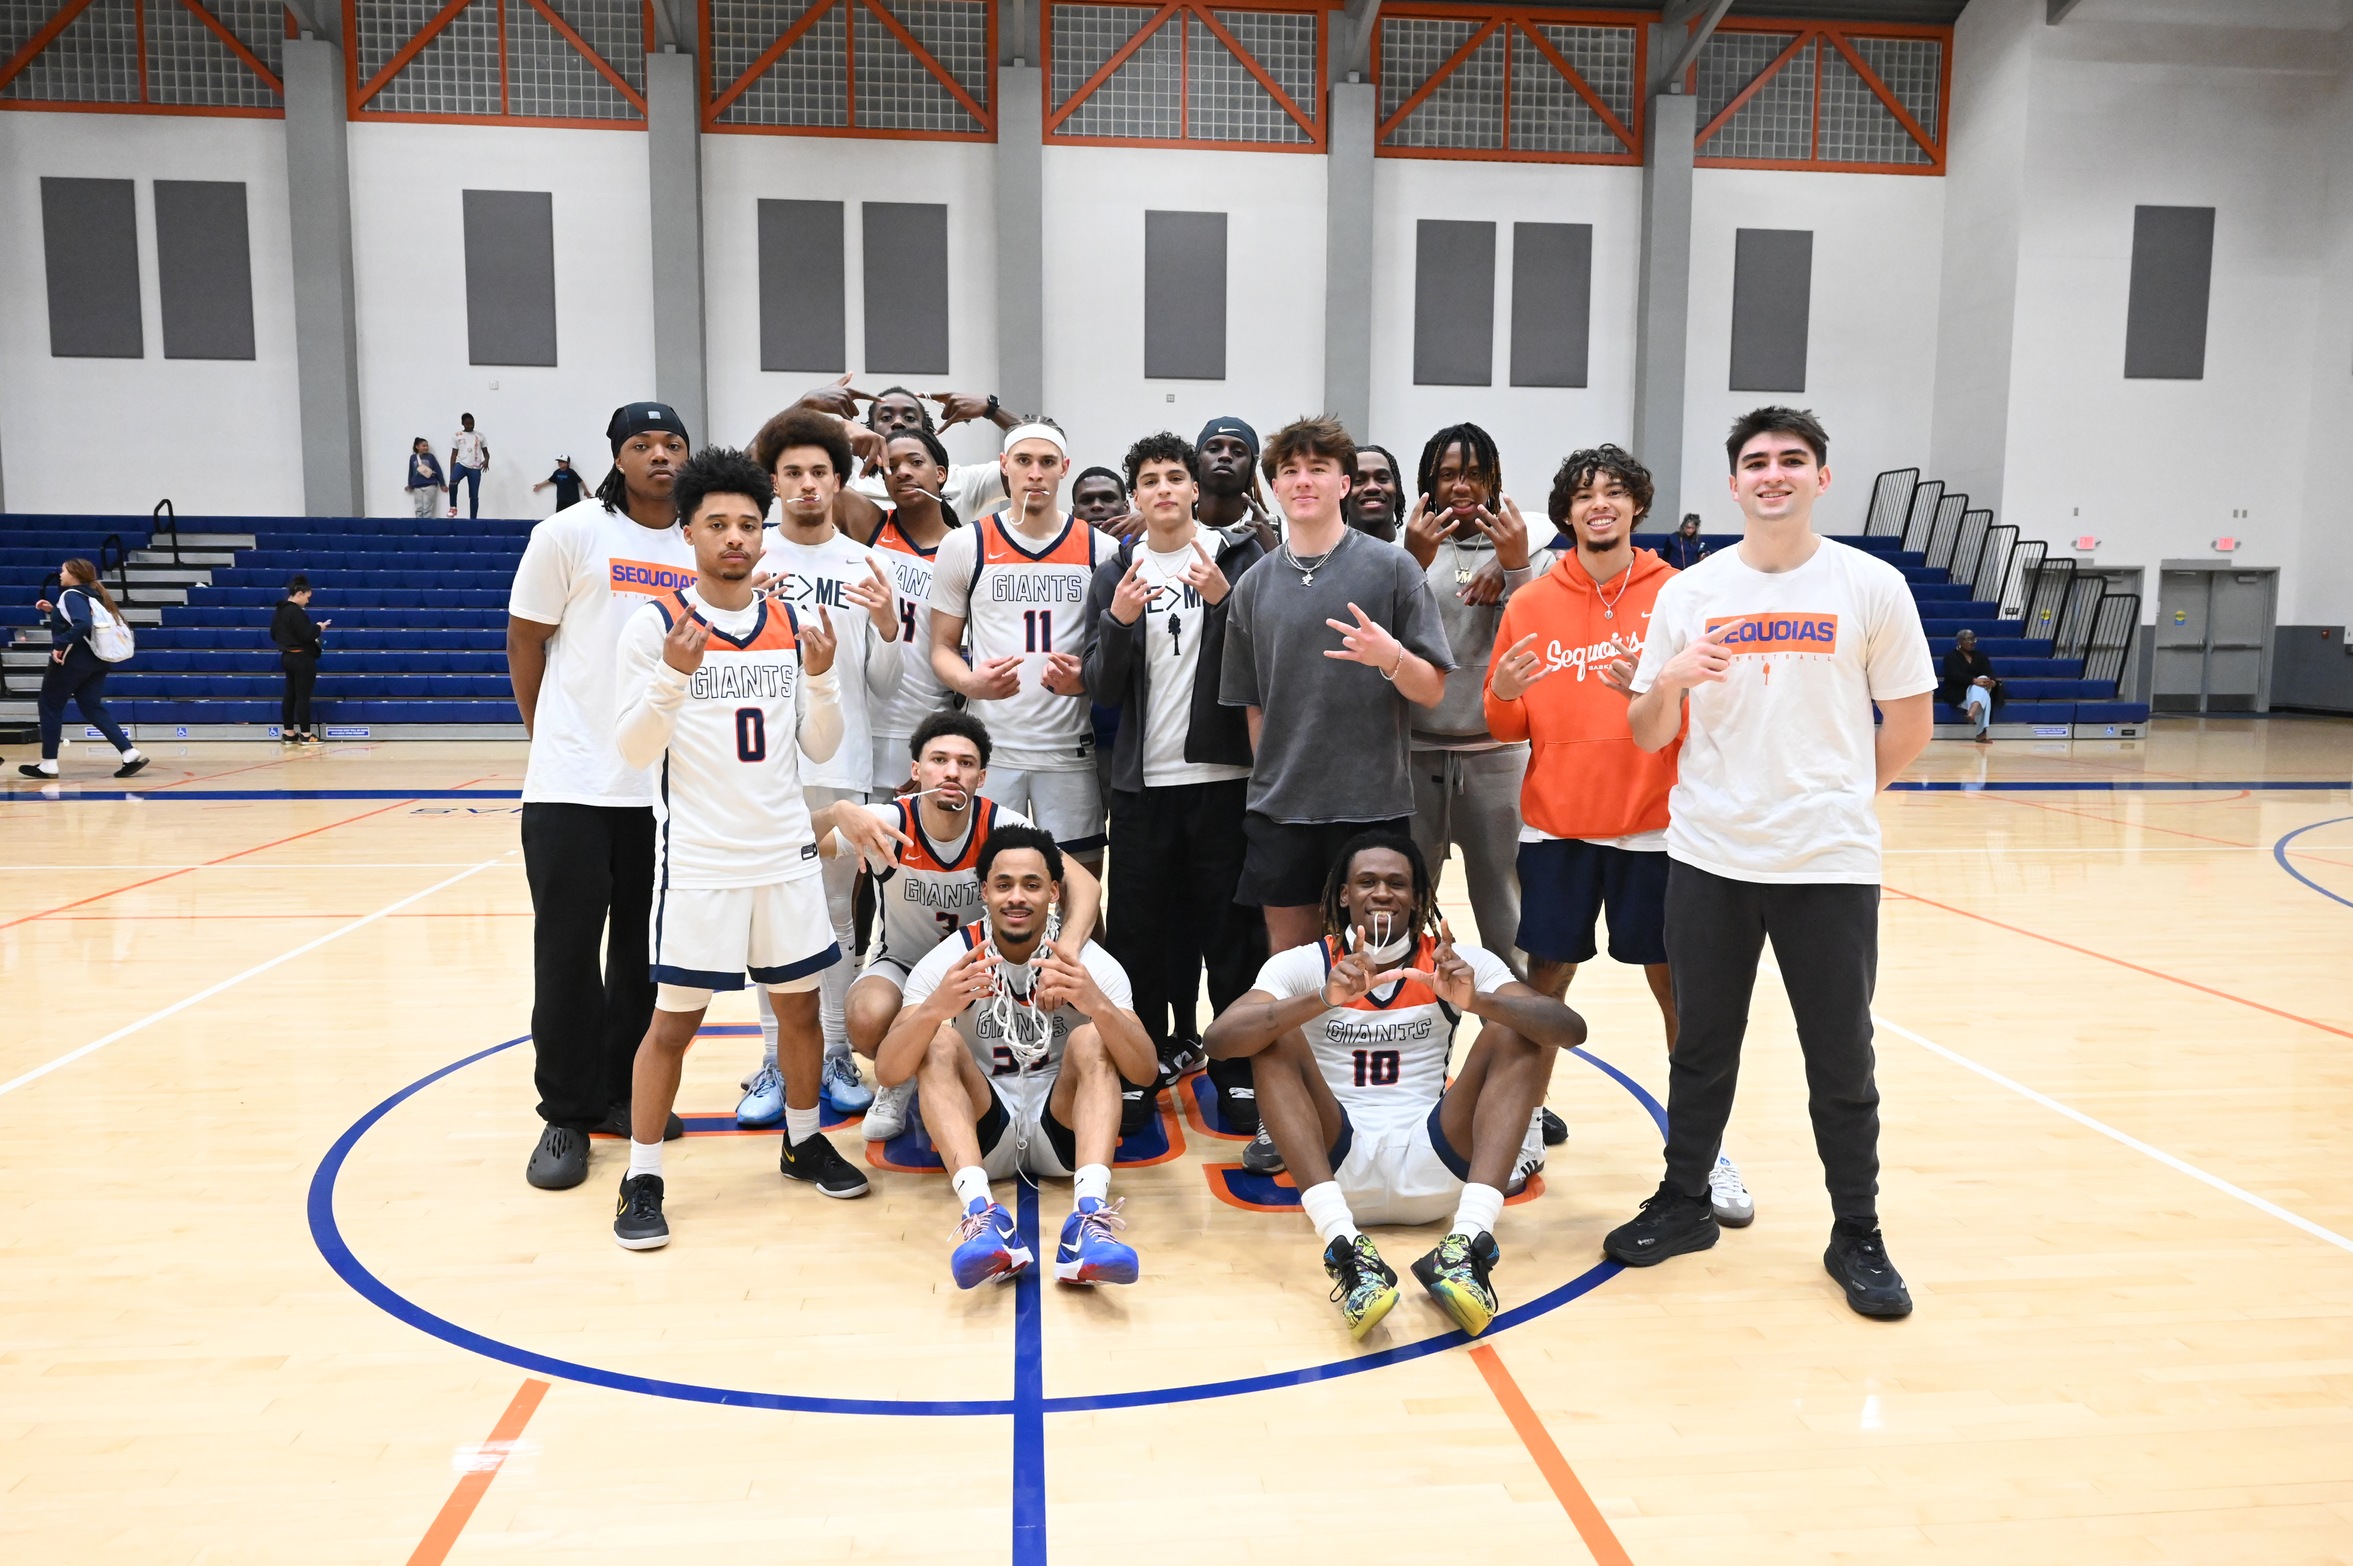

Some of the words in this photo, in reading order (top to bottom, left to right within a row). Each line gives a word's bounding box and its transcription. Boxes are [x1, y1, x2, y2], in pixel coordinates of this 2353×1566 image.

[992, 574, 1082, 602] GIANTS
[1023, 609, 1052, 653] 11
[1546, 631, 1645, 682] Sequois
[690, 665, 793, 699] GIANTS
[735, 707, 766, 763] 0
[904, 878, 983, 909] GIANT
[1326, 1018, 1432, 1044] GIANTS
[1352, 1049, 1401, 1087] 10
